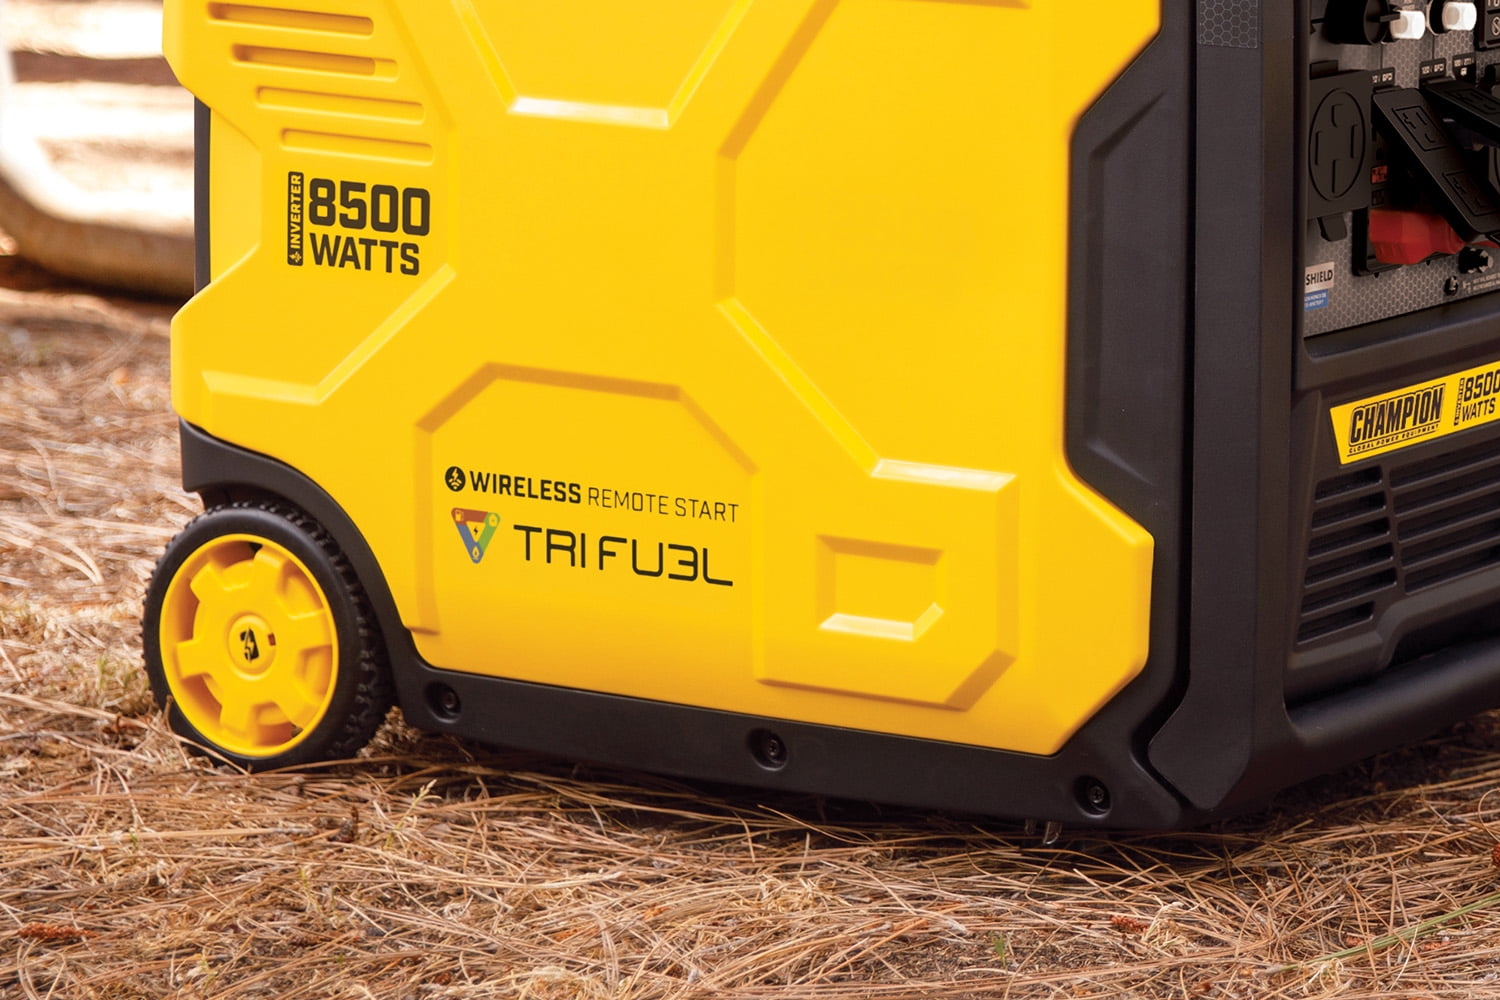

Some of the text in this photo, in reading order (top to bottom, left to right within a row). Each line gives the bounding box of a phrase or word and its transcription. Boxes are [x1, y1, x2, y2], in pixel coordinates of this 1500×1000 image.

[290, 174, 302, 249] INVERTER
[309, 178, 430, 236] 8500
[309, 232, 420, 276] WATTS
[1306, 270, 1333, 286] SHIELD
[1350, 386, 1443, 443] CHAMPION
[1462, 397, 1496, 422] WATTS
[470, 470, 739, 523] WIRELESS REMOTE START
[513, 524, 586, 569] TRI
